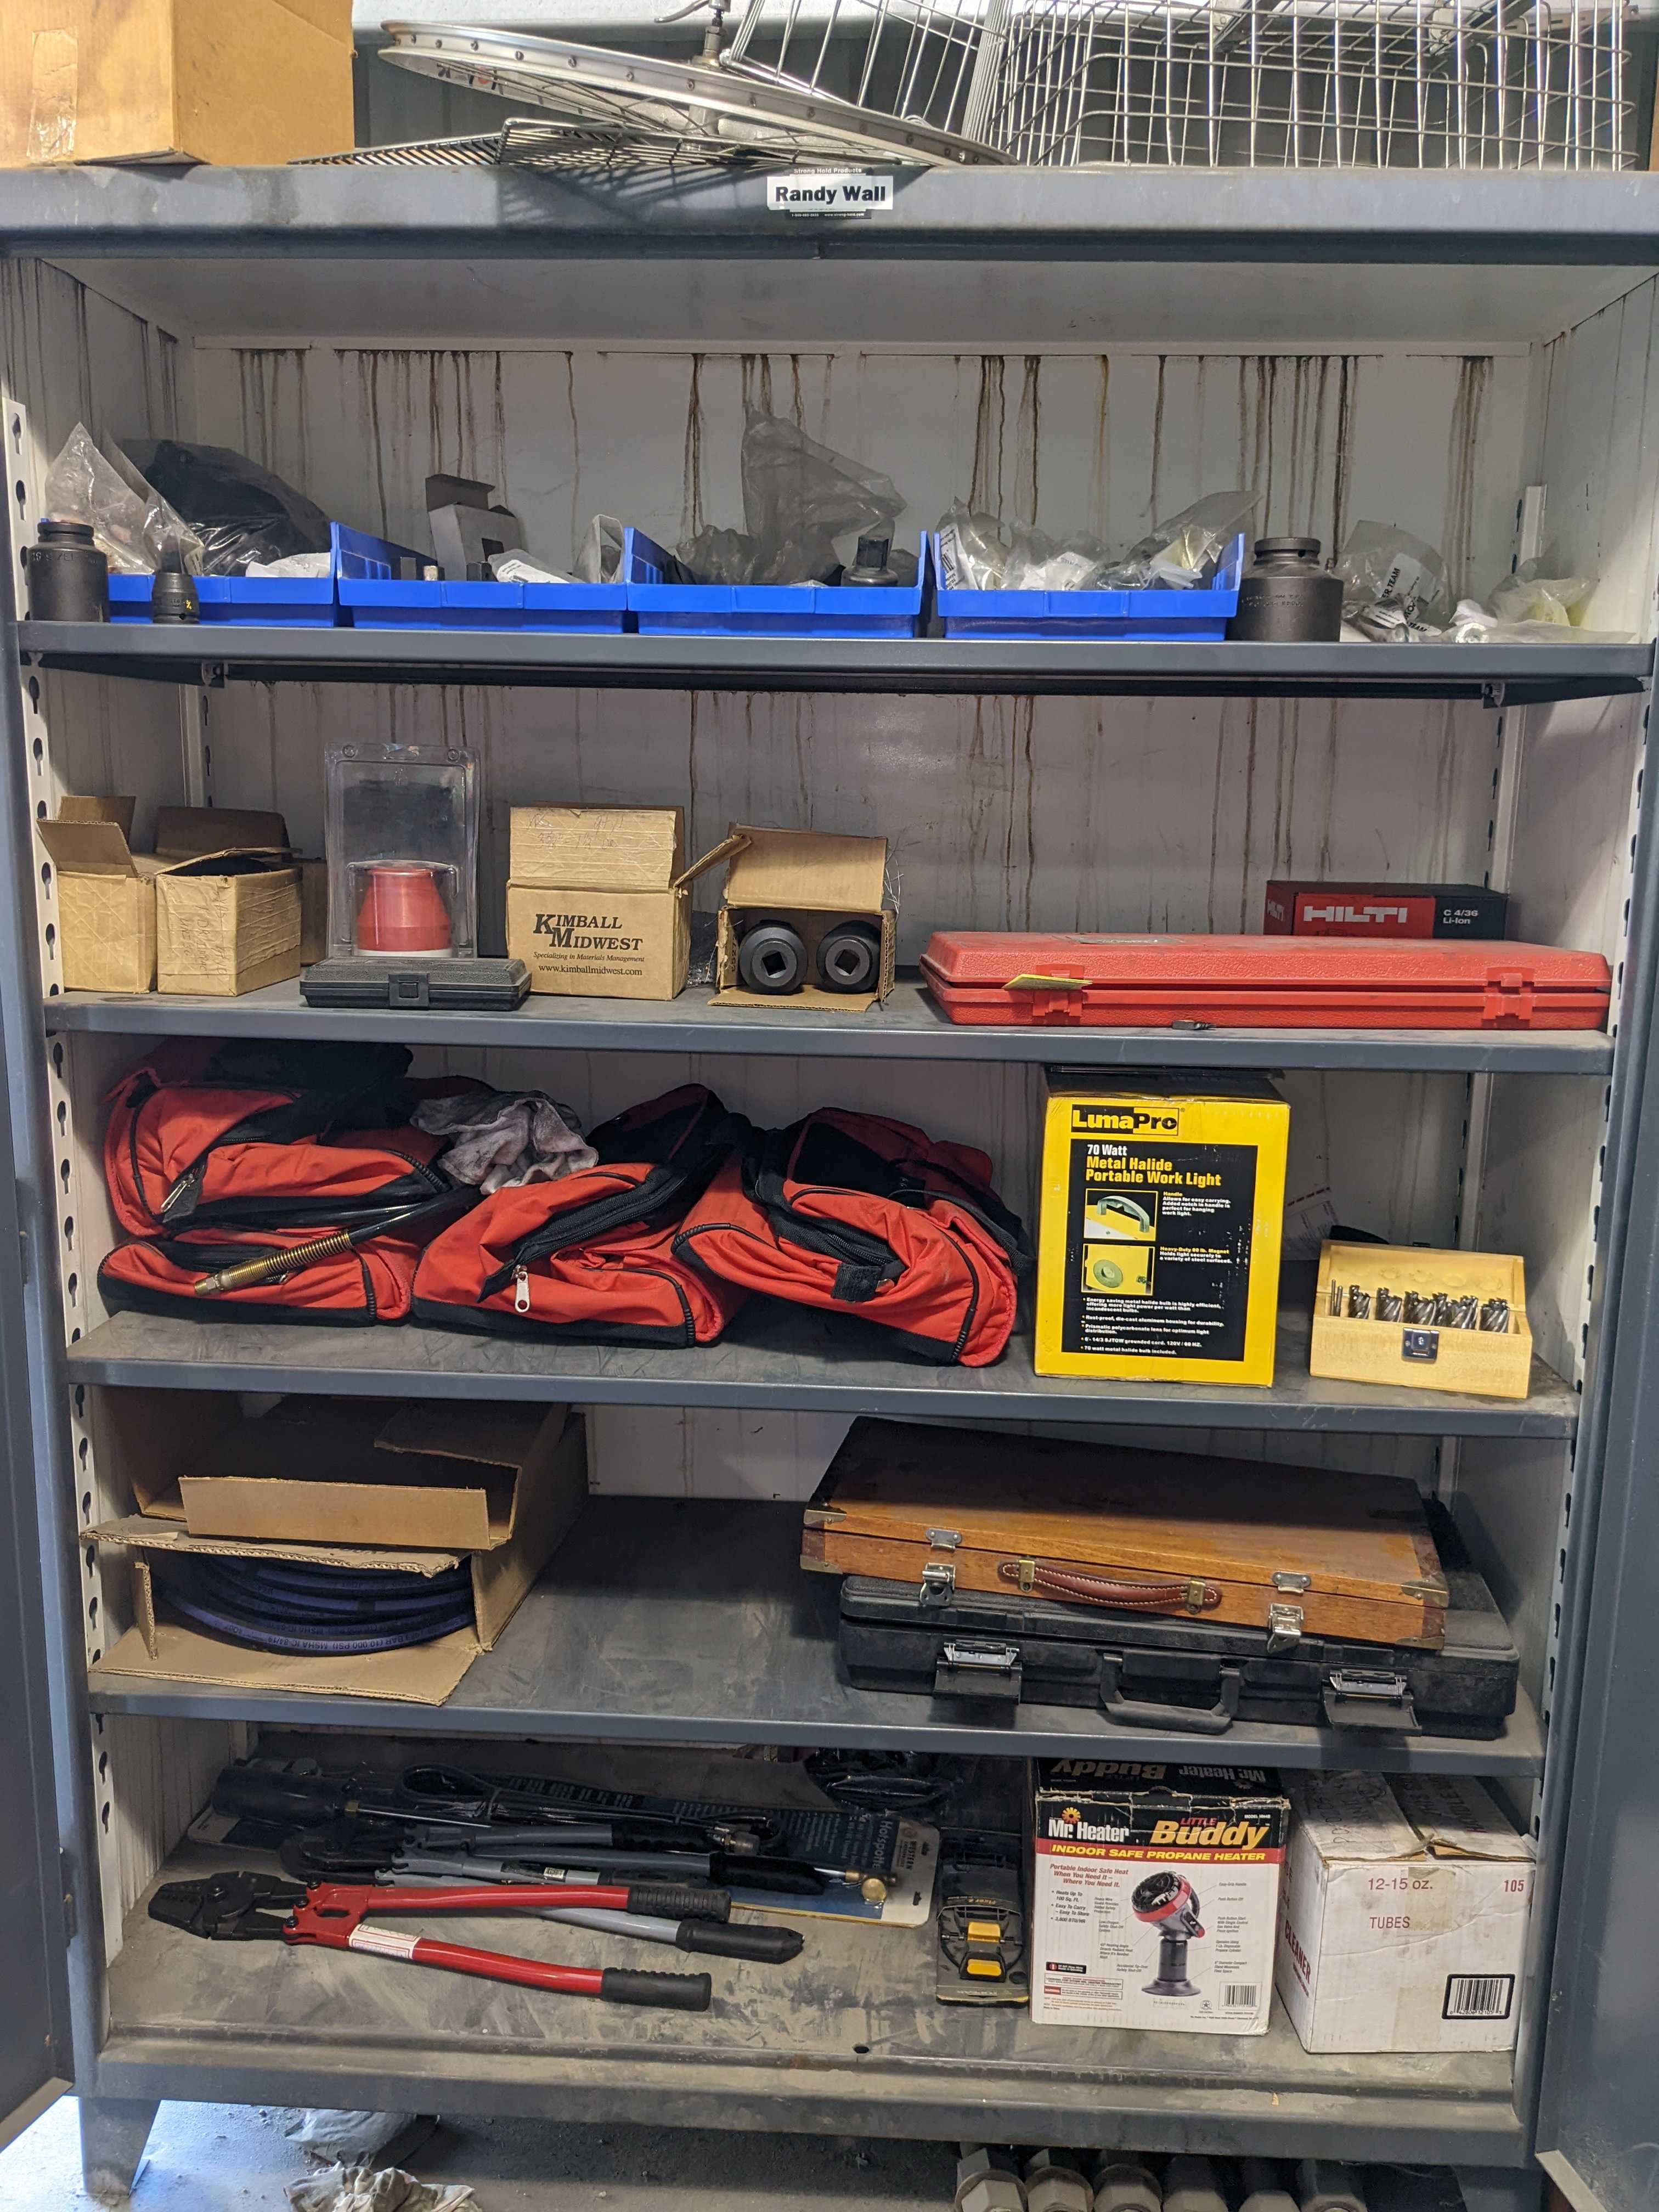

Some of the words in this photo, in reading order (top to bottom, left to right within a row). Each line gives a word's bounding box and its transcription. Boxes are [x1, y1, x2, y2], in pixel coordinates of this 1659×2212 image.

[776, 186, 837, 205] Randy
[843, 186, 885, 201] Wall
[1387, 568, 1400, 590] TEAM
[1304, 906, 1407, 923] HILTI
[533, 913, 622, 934] KIMBALL
[549, 927, 642, 950] MIDWEST
[533, 952, 567, 960] Specializing
[539, 965, 642, 975] www.kimballmidwest.com
[1073, 1110, 1177, 1130] LumaPro
[1087, 1144, 1099, 1155] 70
[1102, 1145, 1127, 1156] Watt
[1087, 1156, 1126, 1169] Metal
[1130, 1158, 1172, 1171] Halide
[1086, 1169, 1143, 1183] Portable
[1147, 1171, 1182, 1184] Work
[1186, 1172, 1221, 1188] Light
[303, 1641, 329, 1650] MSHA
[1051, 1758, 1166, 1779] Buddy
[1179, 1765, 1235, 1780] Heater
[1238, 1767, 1266, 1782] Mr.
[1180, 1818, 1217, 1826] LITTLE
[1049, 1818, 1074, 1839] Mr.
[1077, 1822, 1129, 1843] Heater
[1150, 1820, 1269, 1850] Buddy
[1052, 1844, 1105, 1856] INDOOR
[1108, 1848, 1144, 1858] SAFE
[1147, 1850, 1210, 1860] PROPANE
[1214, 1852, 1266, 1860] HEATER
[1368, 1878, 1408, 1890] 12-15
[1412, 1880, 1432, 1889] oz.
[1504, 1880, 1524, 1892] 105
[1369, 1916, 1410, 1929] TUBES
[1285, 1920, 1311, 1984] CLEANER
